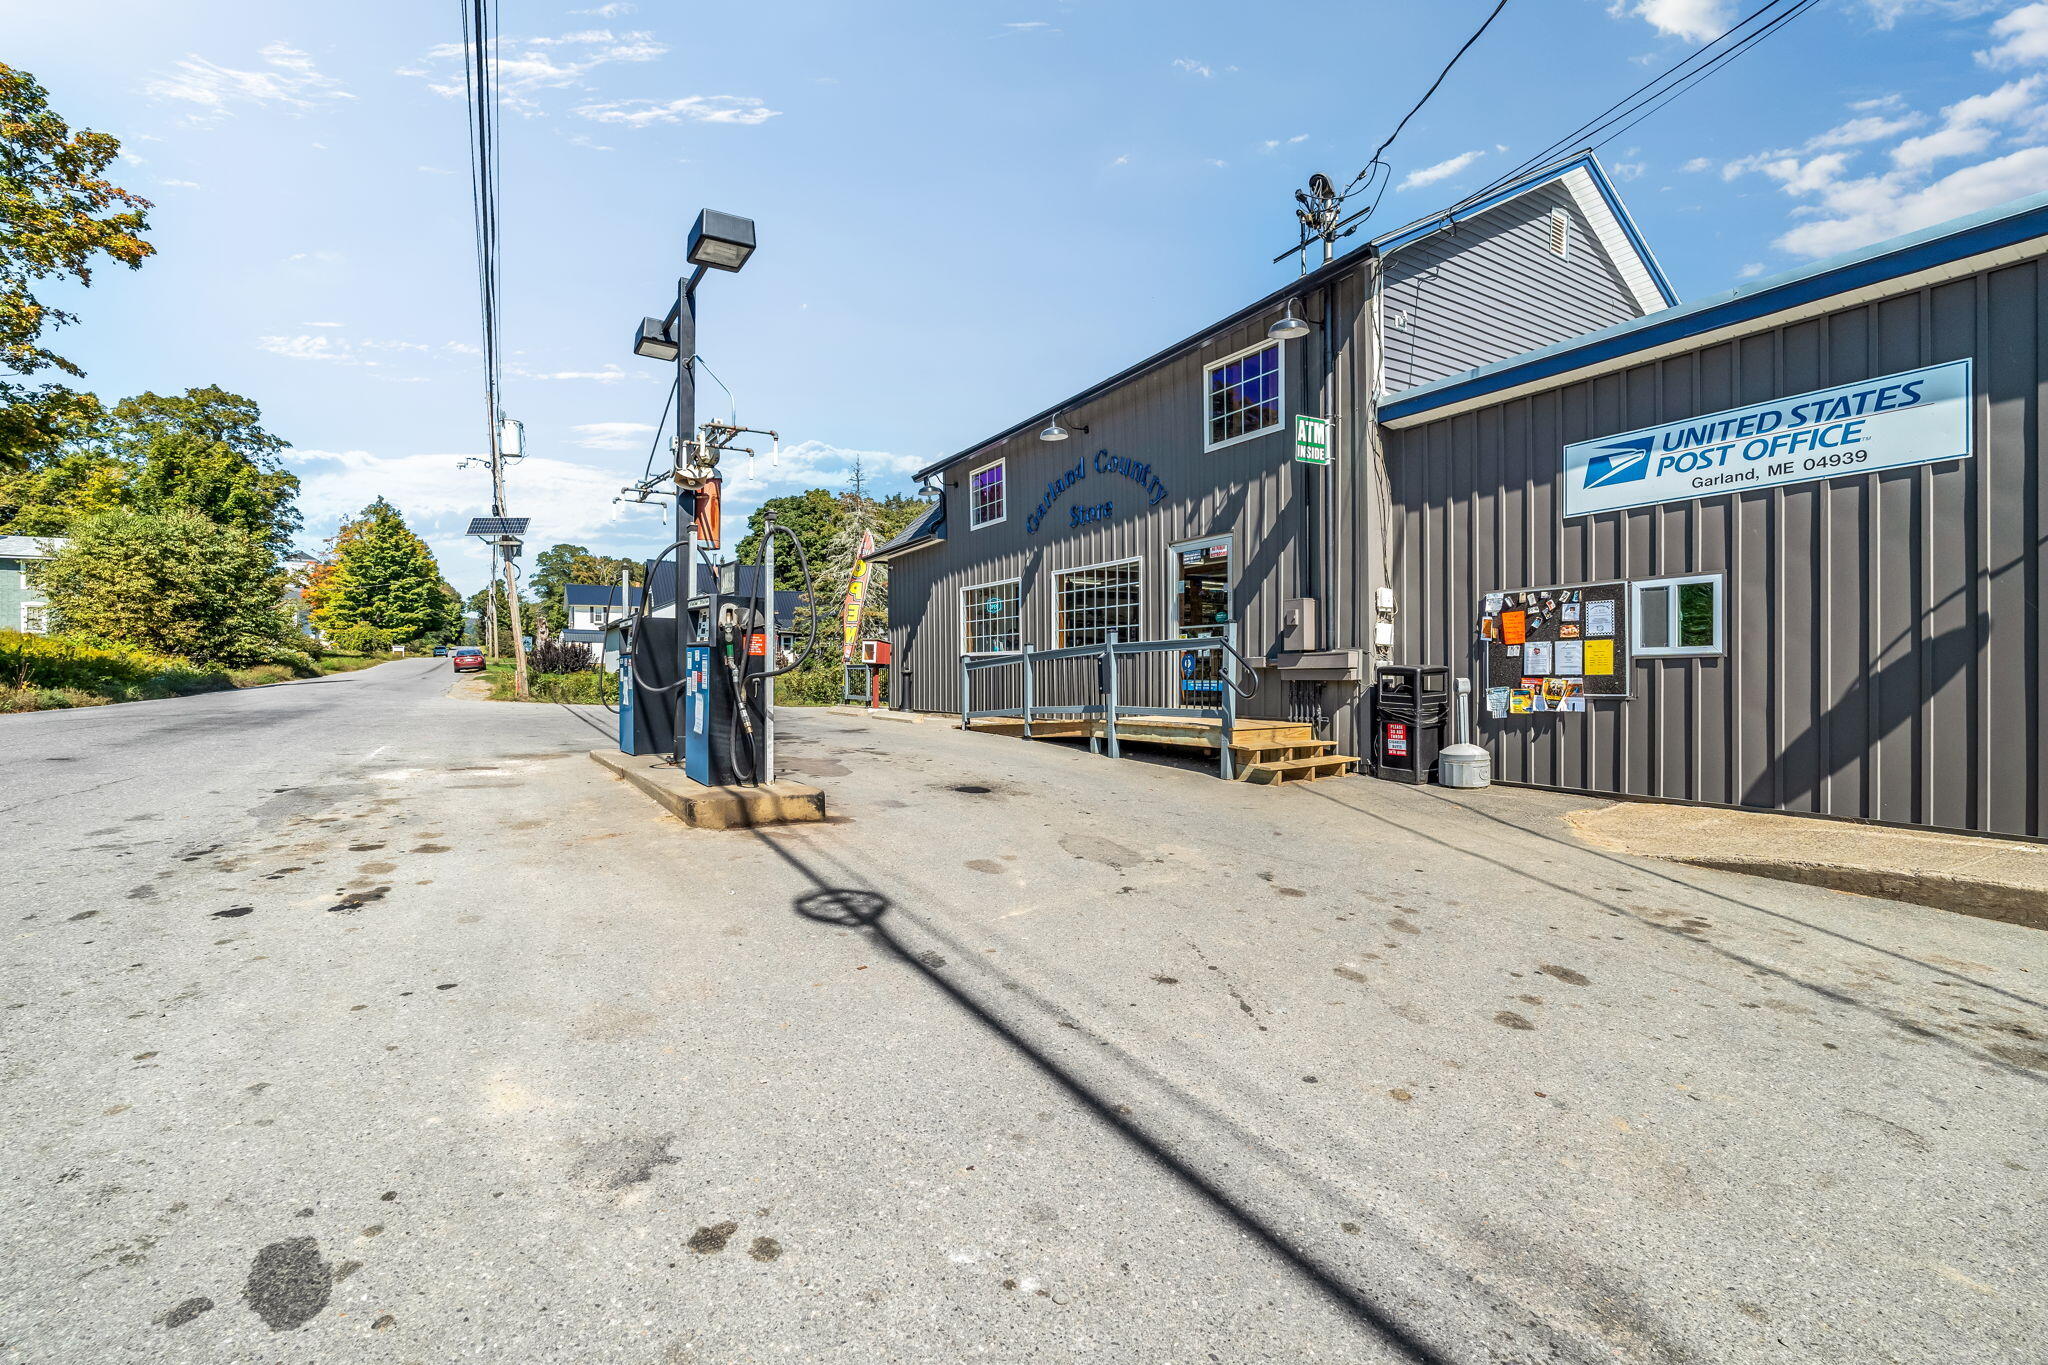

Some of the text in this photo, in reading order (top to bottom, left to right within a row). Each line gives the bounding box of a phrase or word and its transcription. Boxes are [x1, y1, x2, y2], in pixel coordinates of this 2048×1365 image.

[1297, 420, 1325, 445] ATM
[1662, 379, 1924, 452] UNITED STATES
[1297, 445, 1325, 460] INSIDE
[1656, 443, 1737, 478] POST
[1742, 420, 1867, 461] OFFICE
[1691, 449, 1869, 489] Garland, ME 04939
[1026, 449, 1169, 535] Garland Country
[1069, 501, 1113, 528] Store
